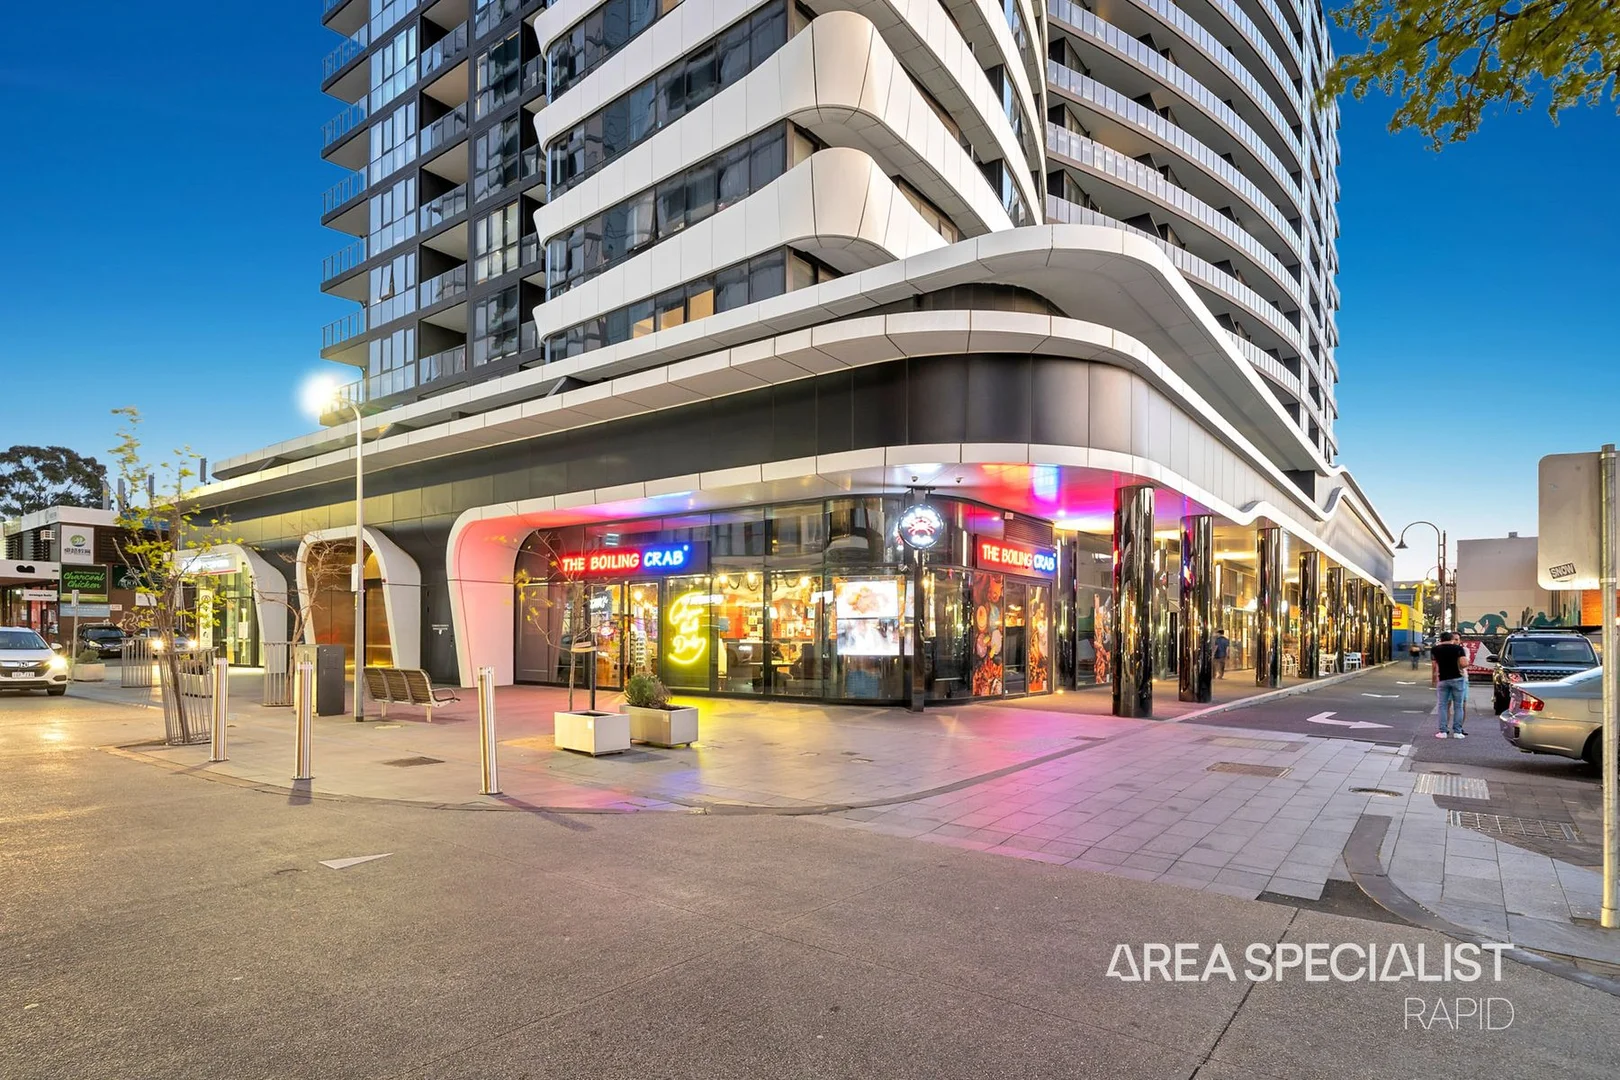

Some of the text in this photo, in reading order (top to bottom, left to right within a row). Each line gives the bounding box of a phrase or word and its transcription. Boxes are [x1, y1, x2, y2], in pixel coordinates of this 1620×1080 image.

[562, 550, 684, 571] THE BOILING CRAB
[982, 544, 1055, 571] THE BOILING CRAB
[63, 571, 105, 581] Charcoal
[1550, 564, 1575, 578] SNOW
[67, 580, 101, 589] Chicken
